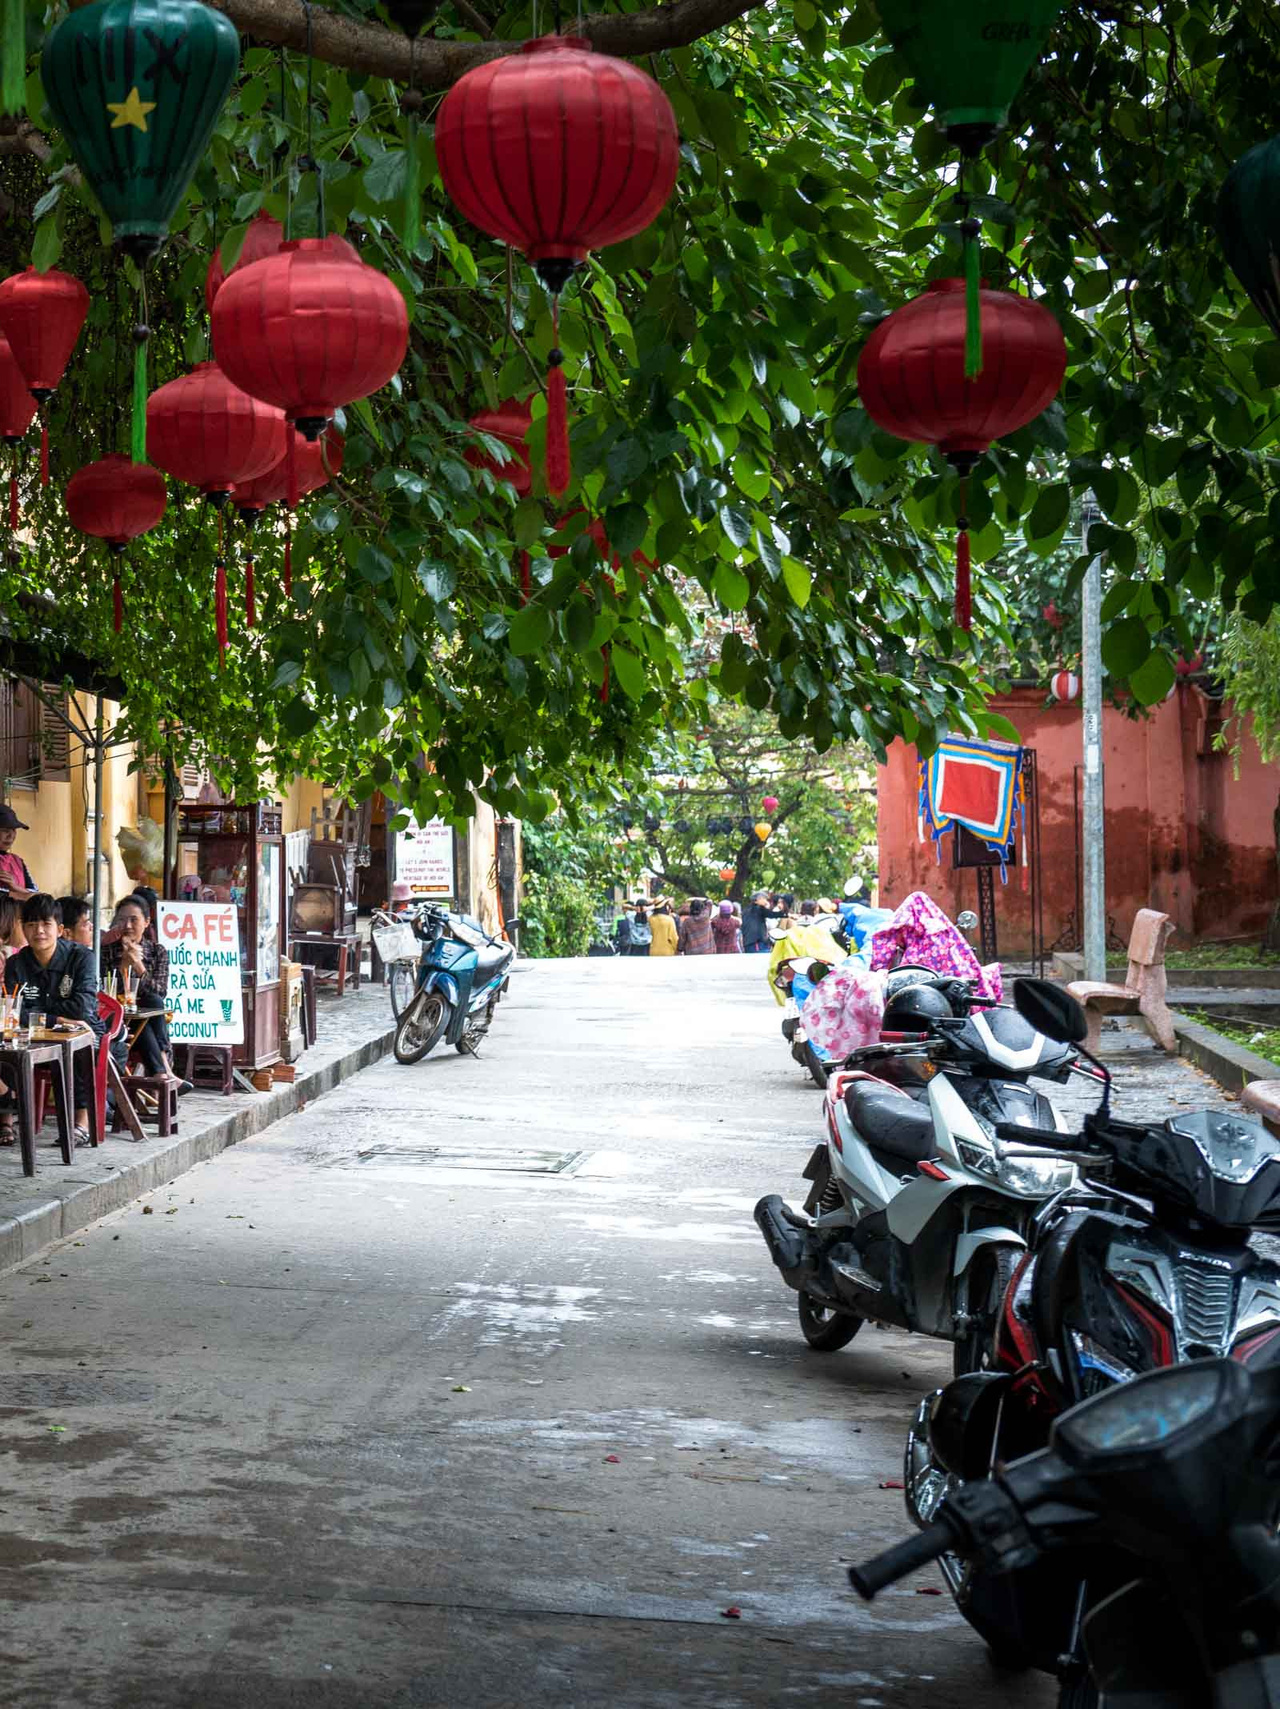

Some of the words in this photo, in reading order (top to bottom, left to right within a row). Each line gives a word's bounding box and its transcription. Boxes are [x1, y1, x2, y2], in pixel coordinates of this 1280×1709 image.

[196, 950, 238, 966] CHANH
[170, 968, 188, 989] RÀ
[187, 998, 205, 1014] ME
[167, 1022, 219, 1038] COCONUT
